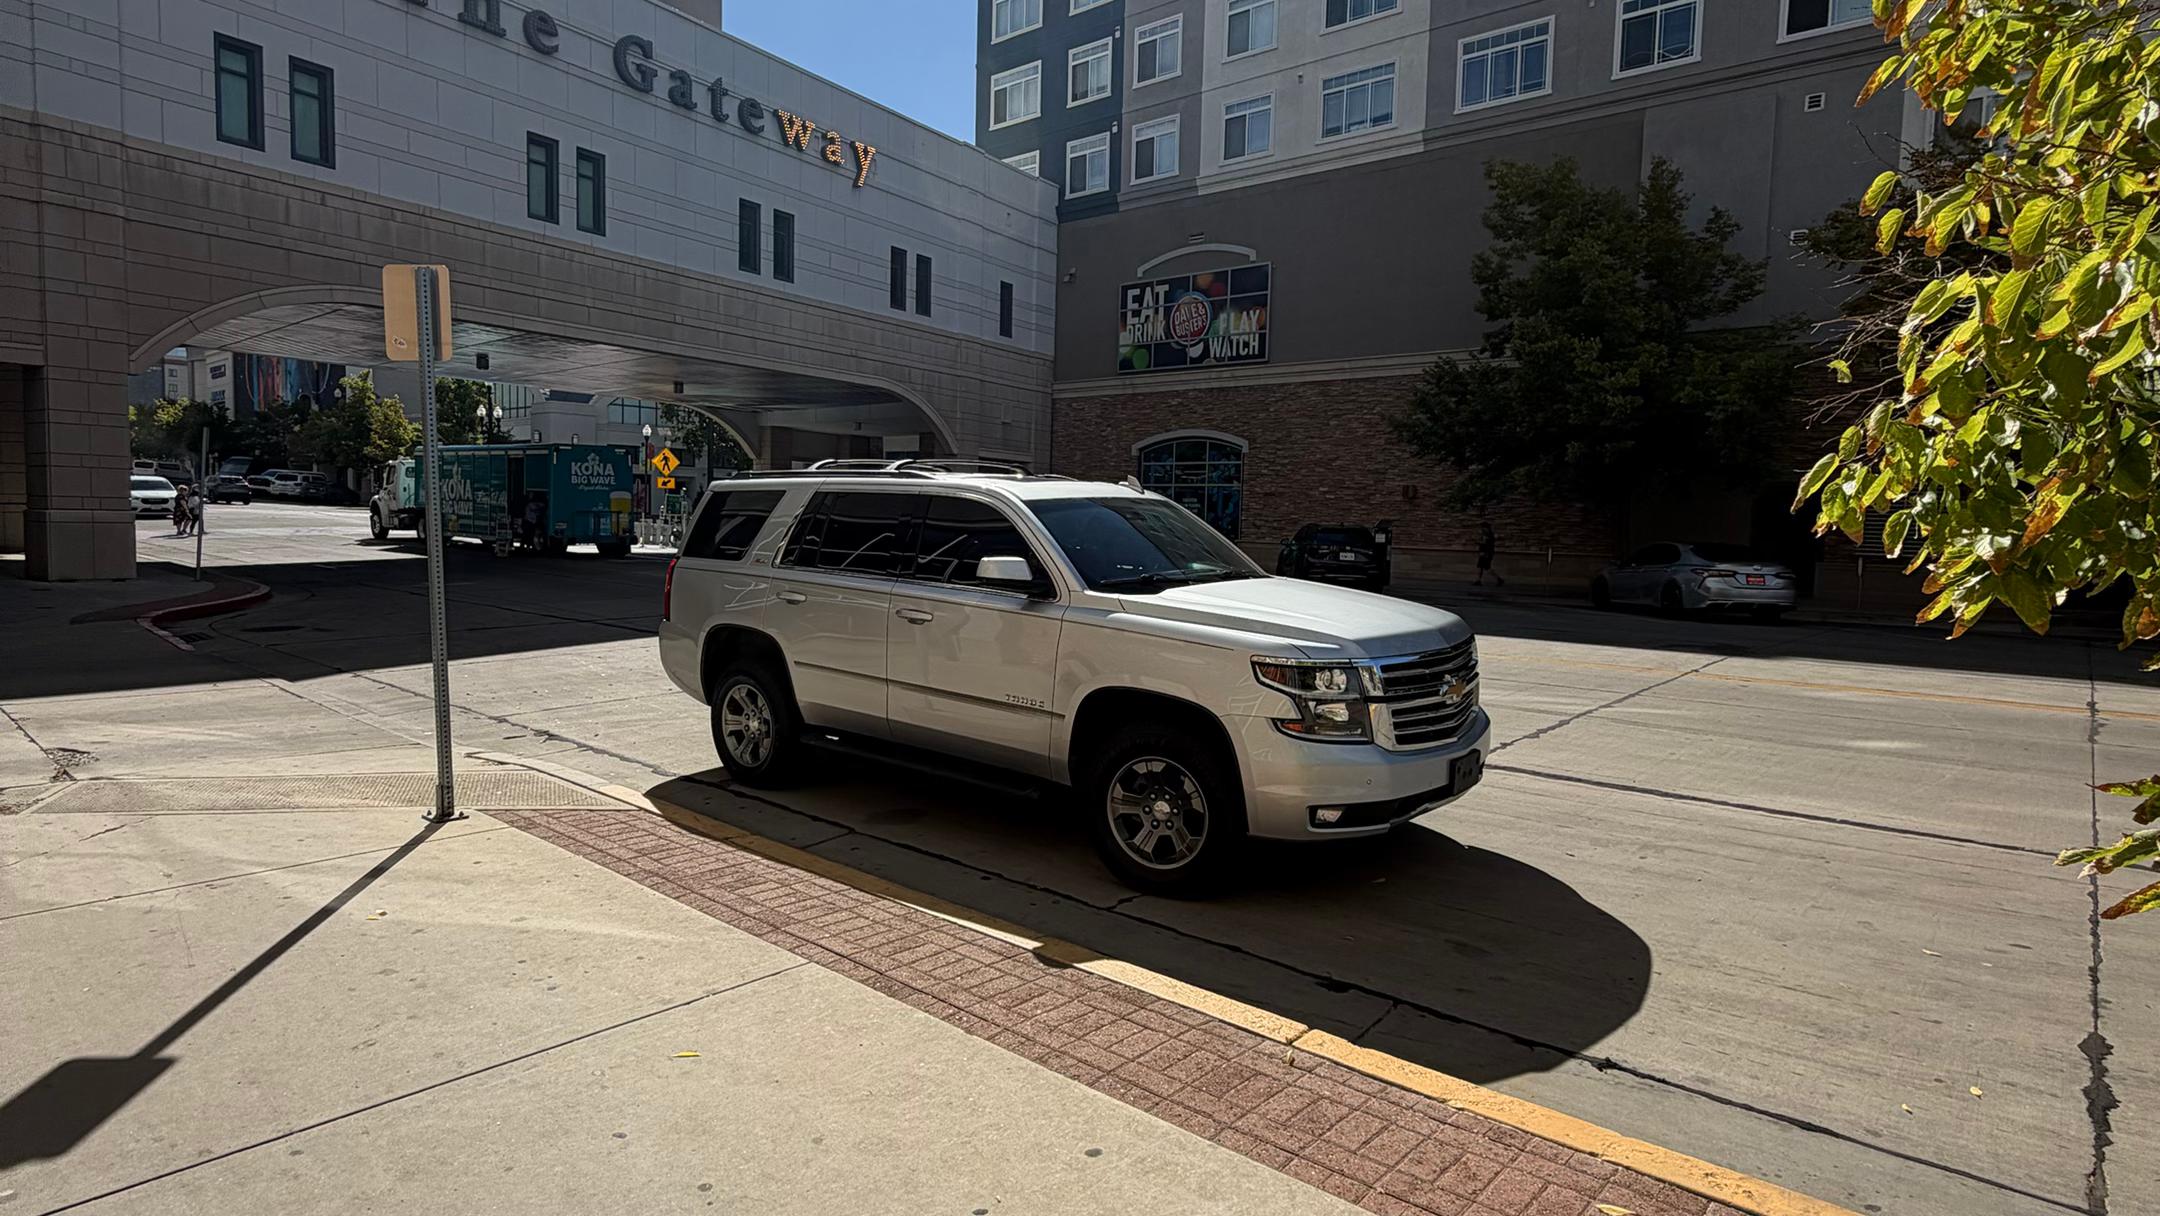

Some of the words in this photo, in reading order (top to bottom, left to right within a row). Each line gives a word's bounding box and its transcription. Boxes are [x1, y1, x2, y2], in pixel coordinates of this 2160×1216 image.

[612, 33, 879, 188] Gateway
[1126, 284, 1170, 325] EAT
[1126, 320, 1166, 345] DRINK
[1219, 309, 1260, 336] PLAY
[1208, 334, 1260, 358] WATCH
[570, 461, 615, 476] KONA
[570, 476, 588, 485] BIG
[589, 476, 616, 485] WAVE
[440, 479, 473, 501] KONA
